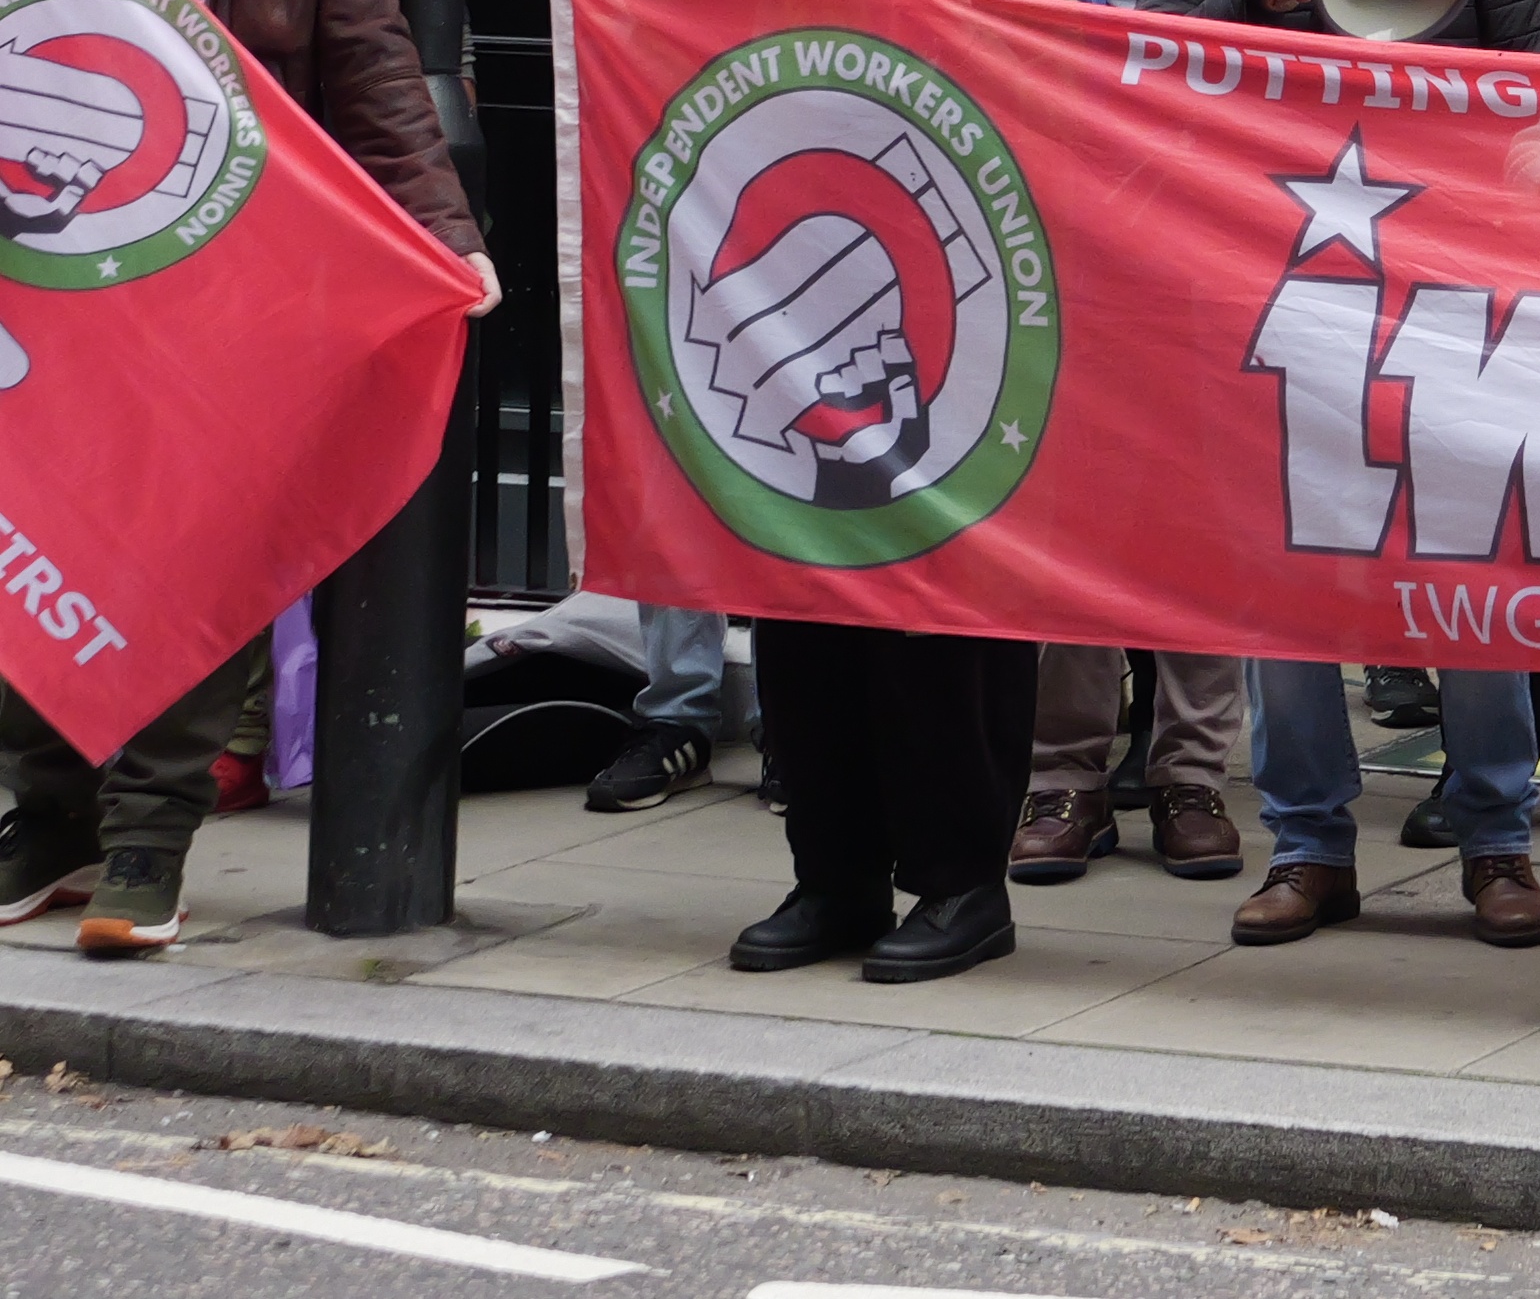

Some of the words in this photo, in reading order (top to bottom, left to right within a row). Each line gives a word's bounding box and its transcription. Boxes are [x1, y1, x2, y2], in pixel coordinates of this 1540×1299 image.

[176, 3, 263, 148] WORKERS
[1121, 31, 1538, 119] PUTTING
[174, 155, 257, 246] UNION
[624, 45, 781, 290] INDEPENDENT
[794, 40, 985, 159] WORKERS
[976, 156, 1049, 328] UNION
